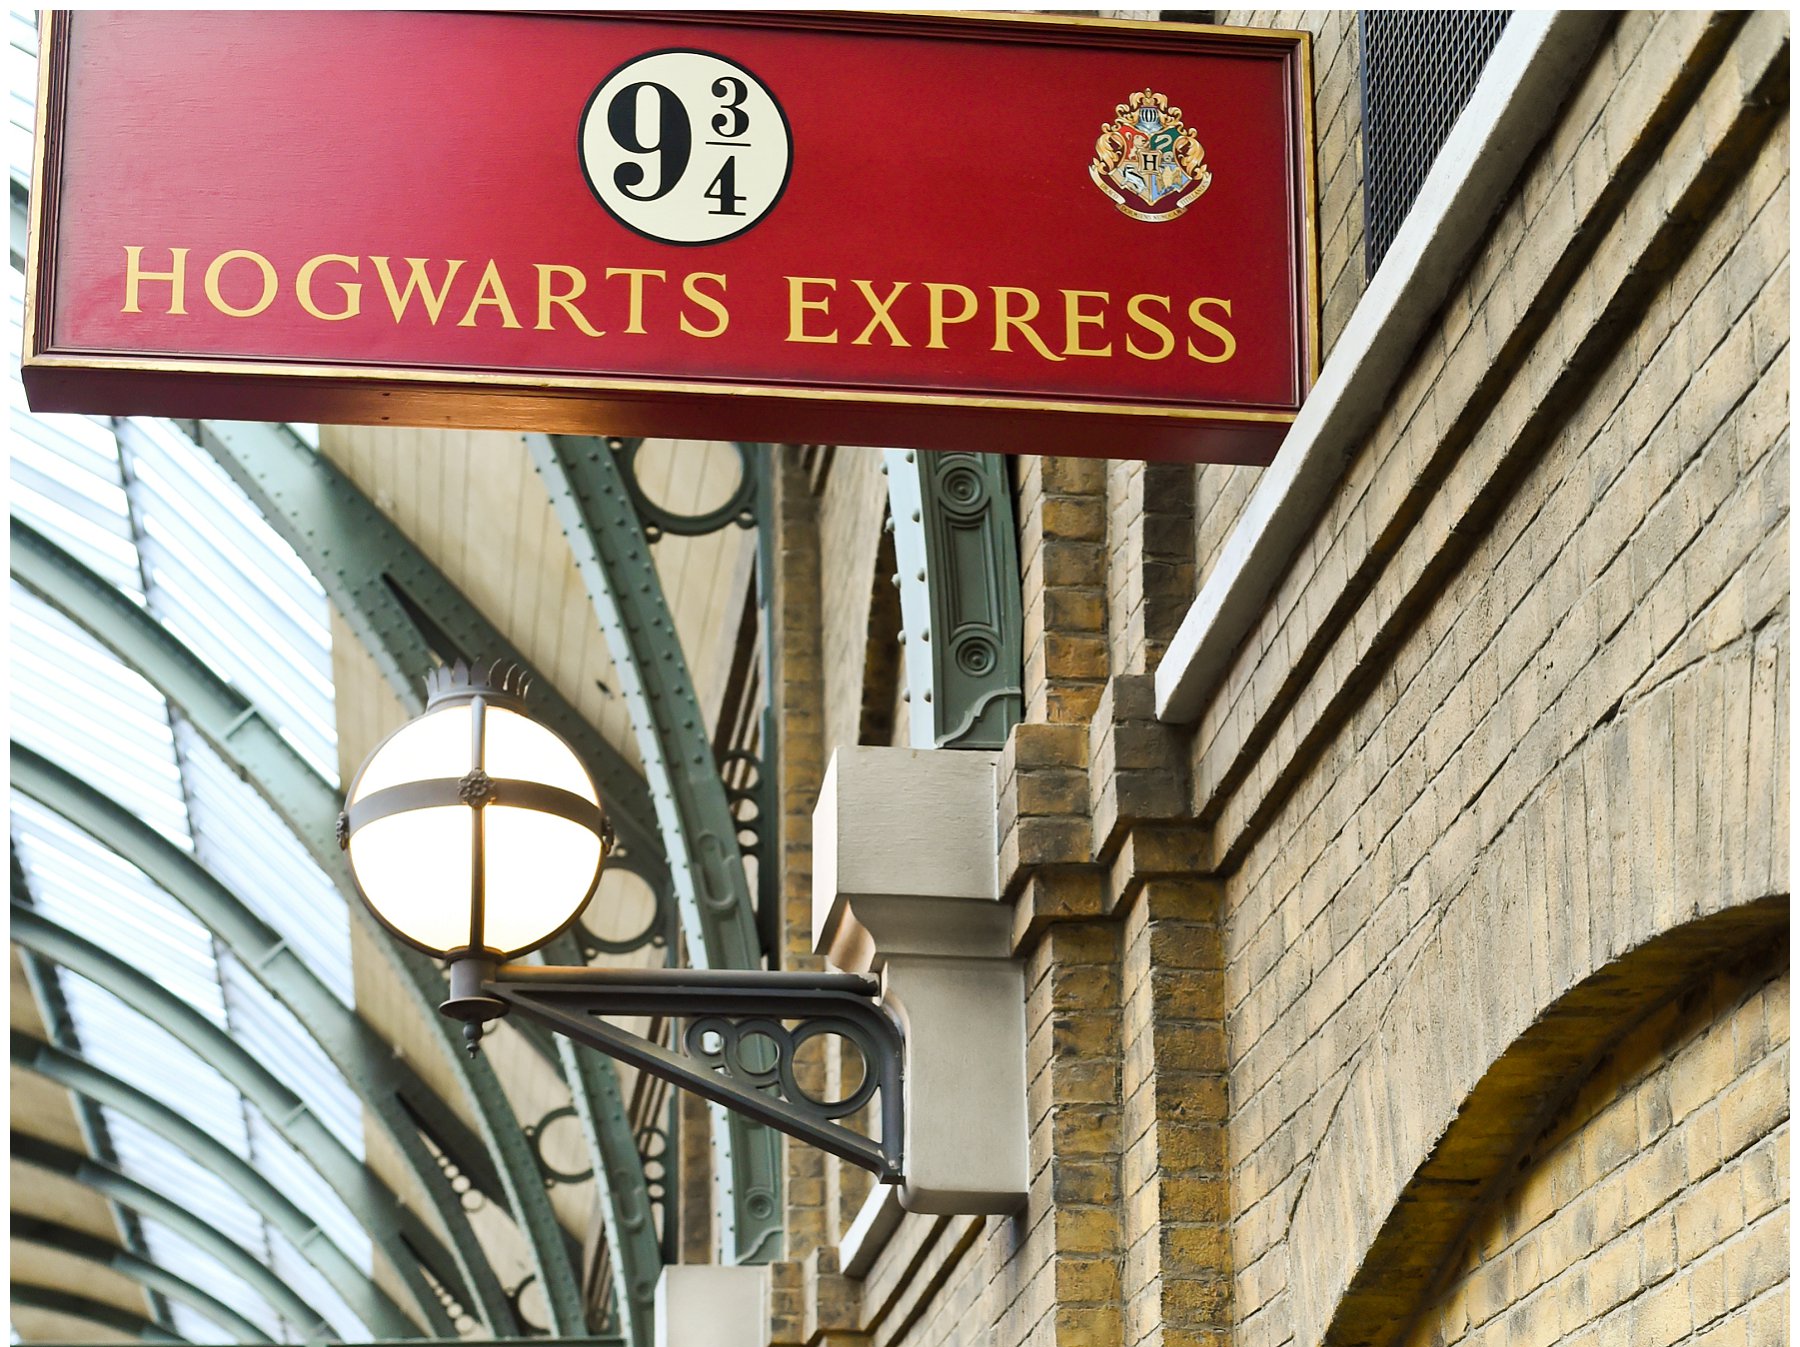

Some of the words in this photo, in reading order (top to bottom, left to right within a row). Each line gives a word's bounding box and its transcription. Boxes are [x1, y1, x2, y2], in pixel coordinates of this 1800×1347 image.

[607, 81, 692, 202] 9
[1143, 154, 1158, 171] H
[120, 245, 730, 338] HOGWARTS
[784, 276, 1237, 364] EXPRESS
